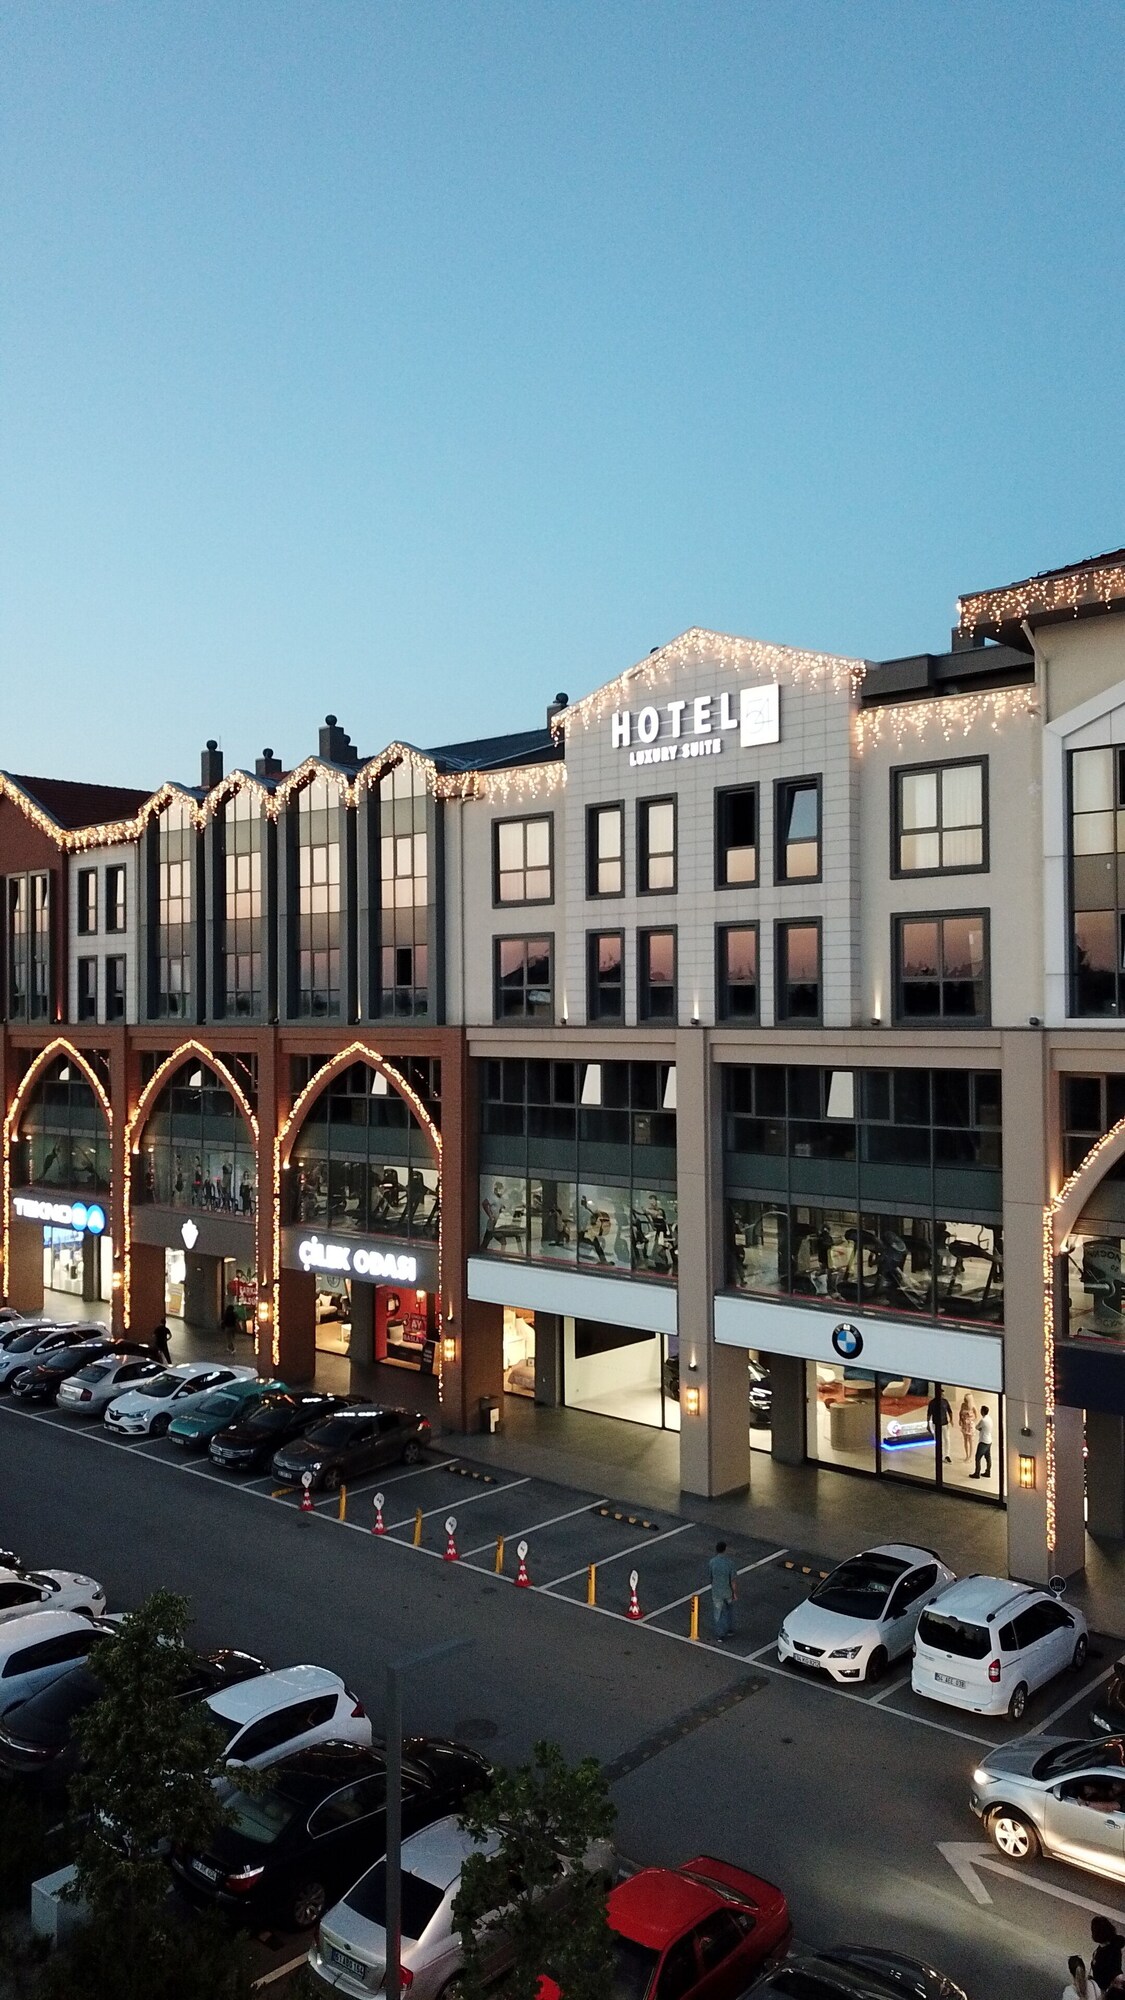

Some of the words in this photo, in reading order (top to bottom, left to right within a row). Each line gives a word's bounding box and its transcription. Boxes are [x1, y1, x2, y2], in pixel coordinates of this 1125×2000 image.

[612, 693, 738, 748] HOTEL
[630, 744, 678, 766] LUXURY
[682, 737, 722, 758] SUITE
[298, 1235, 351, 1272] ÇİLEK
[353, 1249, 417, 1282] ODASI
